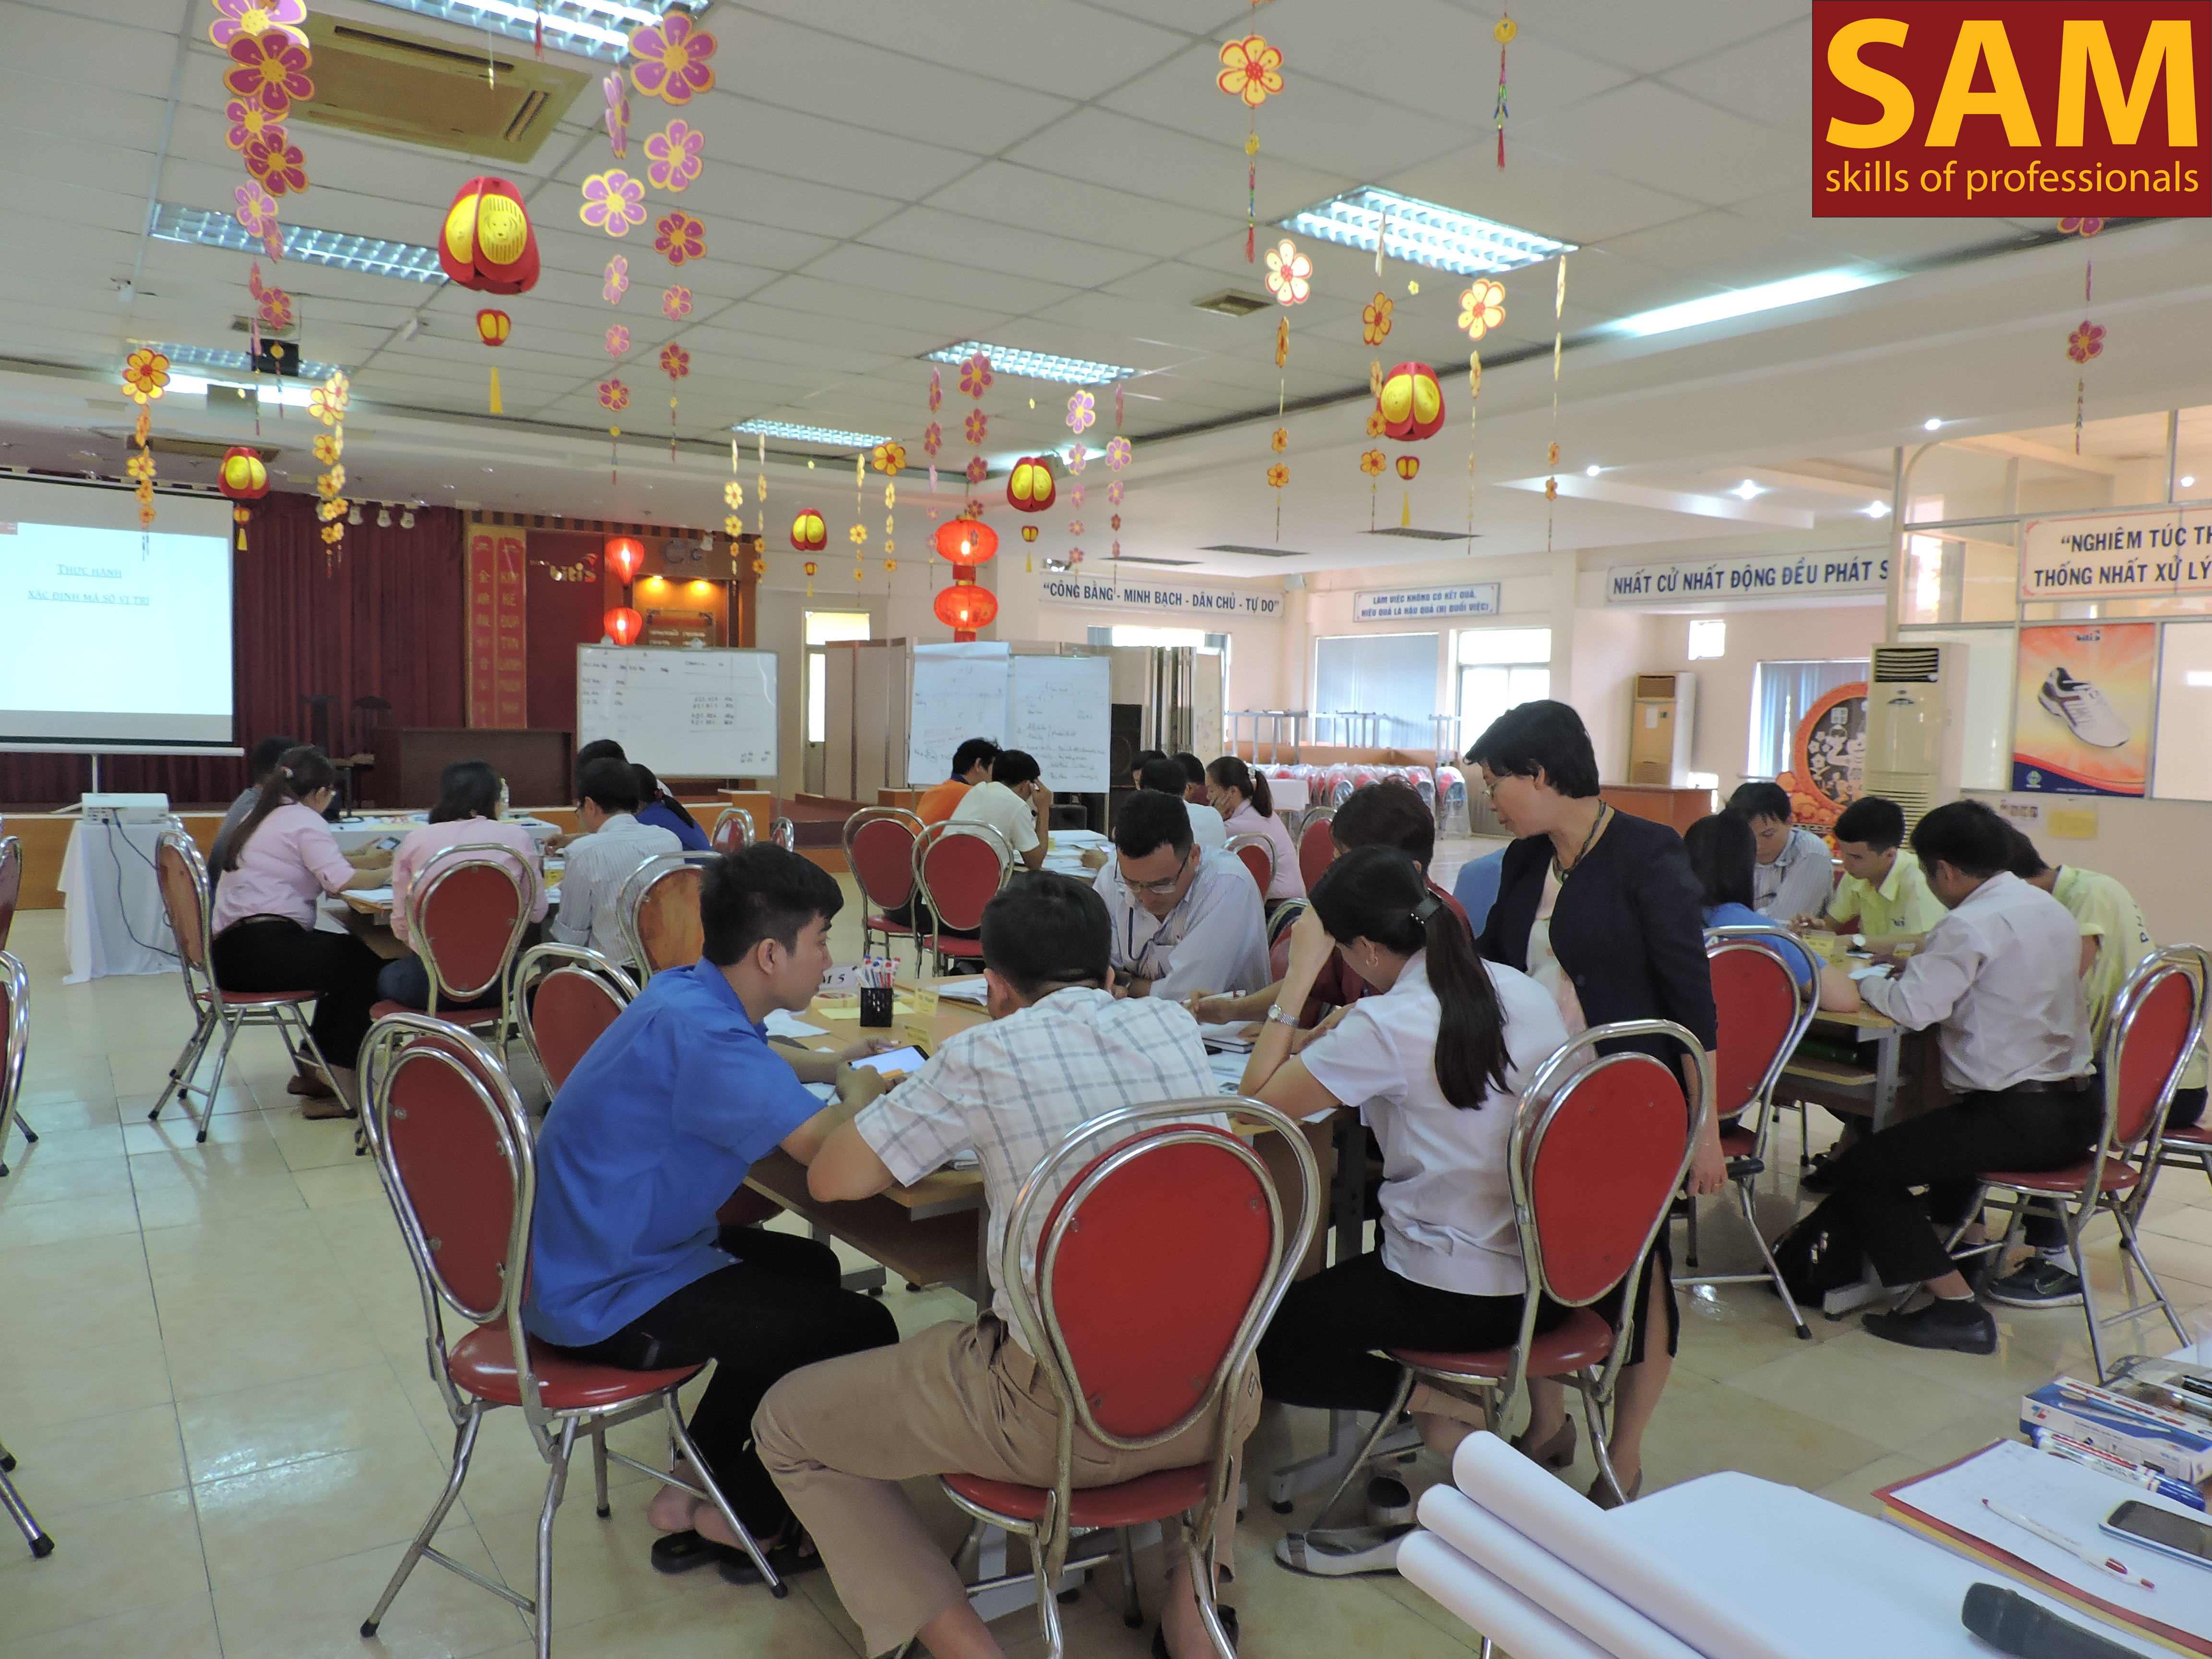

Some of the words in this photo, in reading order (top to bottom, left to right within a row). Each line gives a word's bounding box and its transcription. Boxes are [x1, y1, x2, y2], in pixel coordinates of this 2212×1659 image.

[2149, 523, 2187, 548] TÚC
[1613, 568, 1651, 594] NHẤT
[1657, 566, 1678, 592] CỬ
[1683, 564, 1725, 591] NHẤT
[1731, 564, 1776, 591] ĐỘNG
[1825, 556, 1873, 583] PHÁT
[2034, 560, 2093, 587] THỐNG
[2099, 557, 2148, 584] NHẤT
[2155, 555, 2183, 582] XỬ
[2188, 555, 2212, 580] LÝ
[1084, 580, 1113, 601] BẰNG
[1124, 589, 1151, 603] MINH
[1154, 591, 1182, 608] BẠCH
[1192, 591, 1213, 608] DÂN
[1216, 591, 1236, 610] CHỦ
[1246, 597, 1259, 614] TỰ
